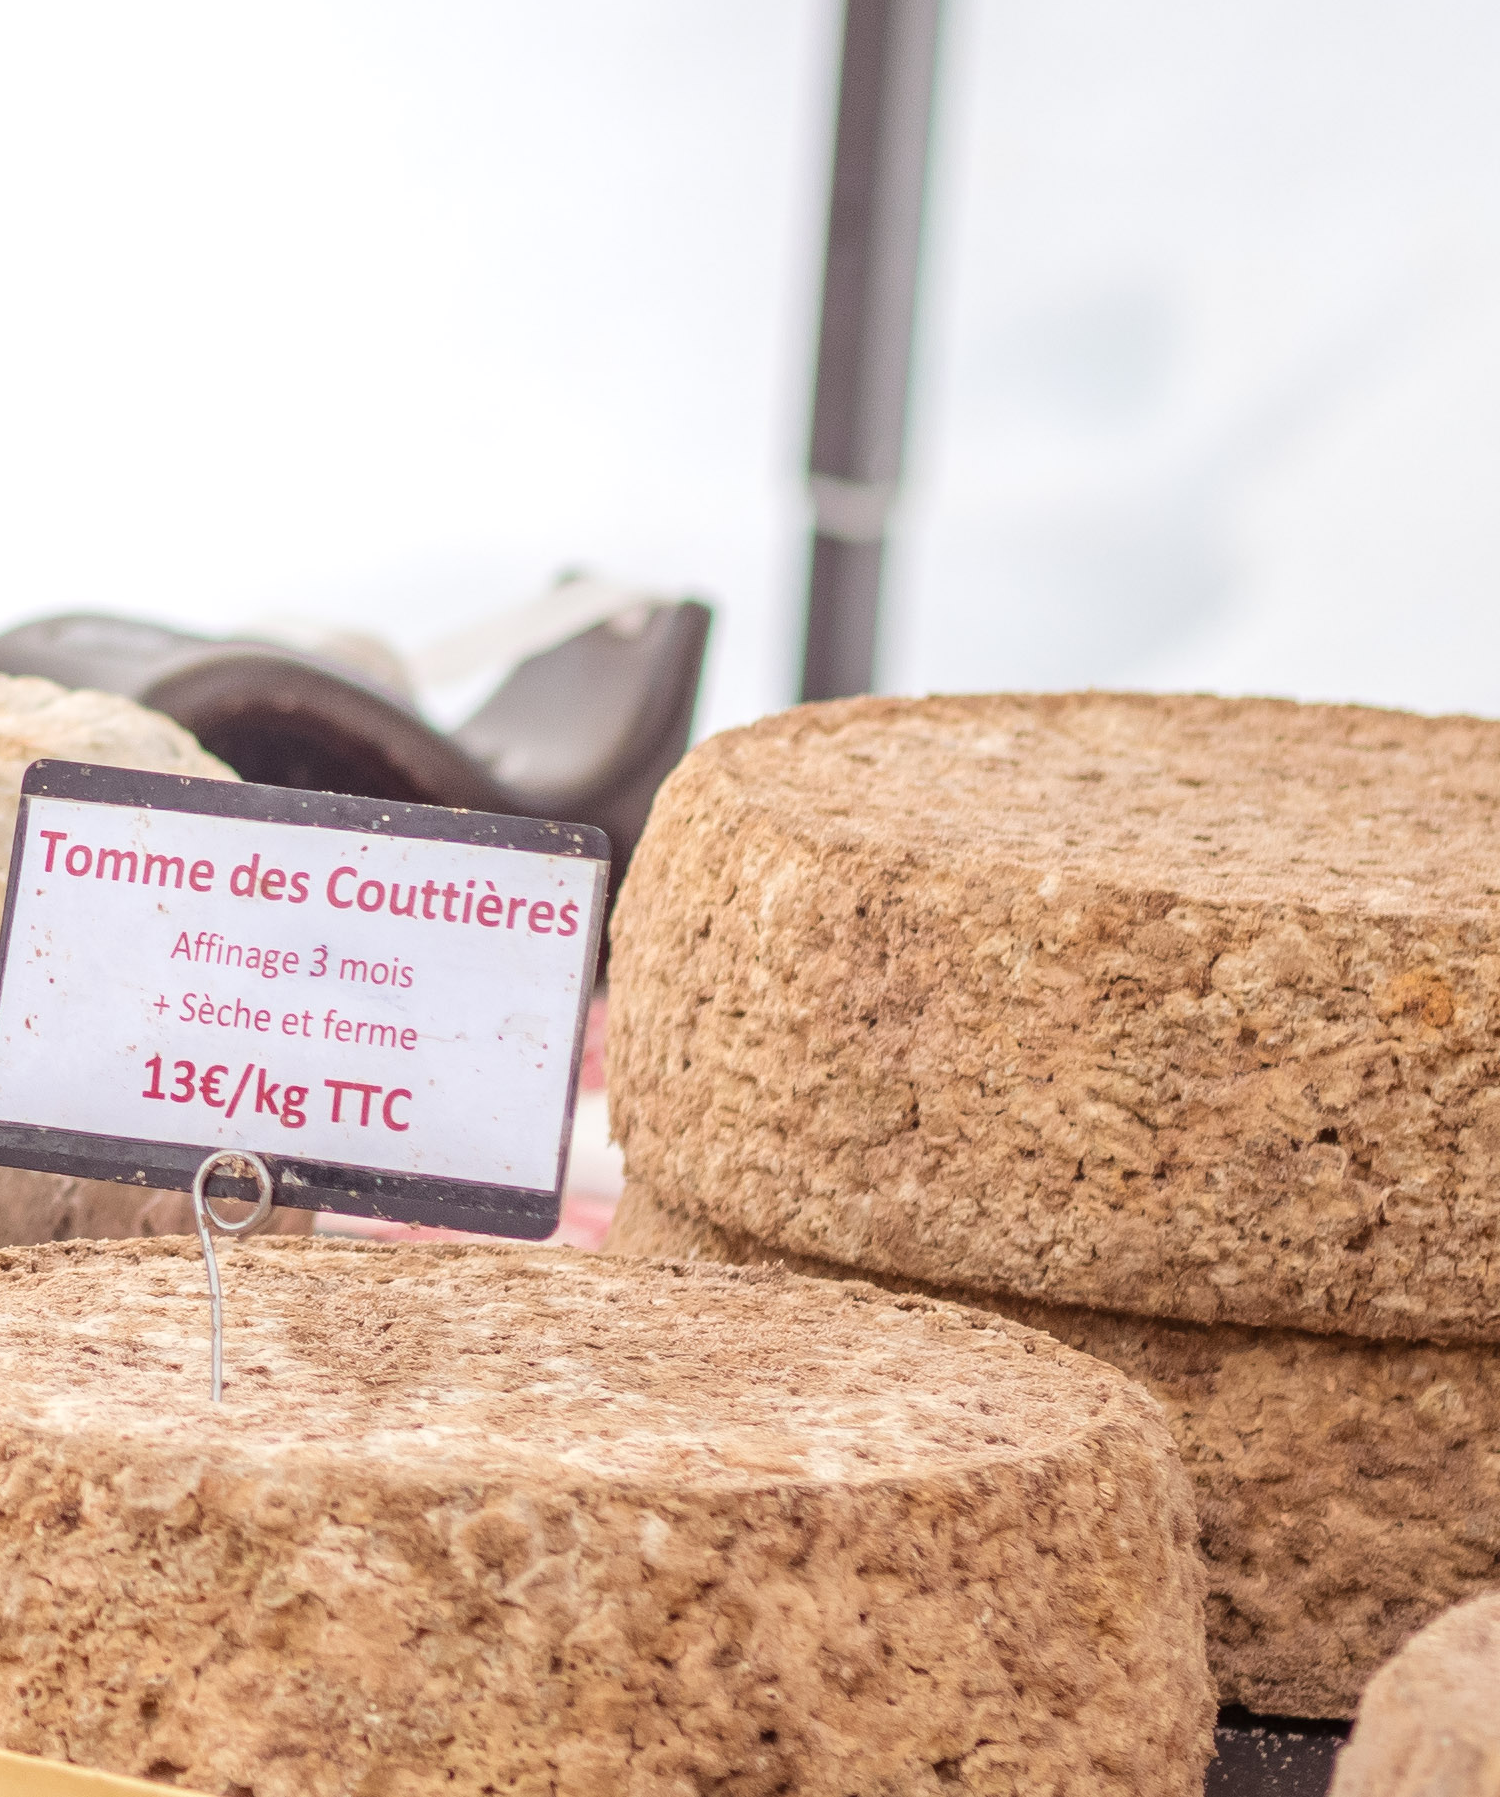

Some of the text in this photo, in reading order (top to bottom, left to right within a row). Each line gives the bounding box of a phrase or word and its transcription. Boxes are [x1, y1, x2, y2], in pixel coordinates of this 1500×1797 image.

[38, 828, 581, 938] Tomme des Couttières
[169, 930, 414, 990] Affinage 3 mois
[152, 991, 419, 1052] + Sèche et ferme
[140, 1052, 414, 1134] 13€/kg TTC
